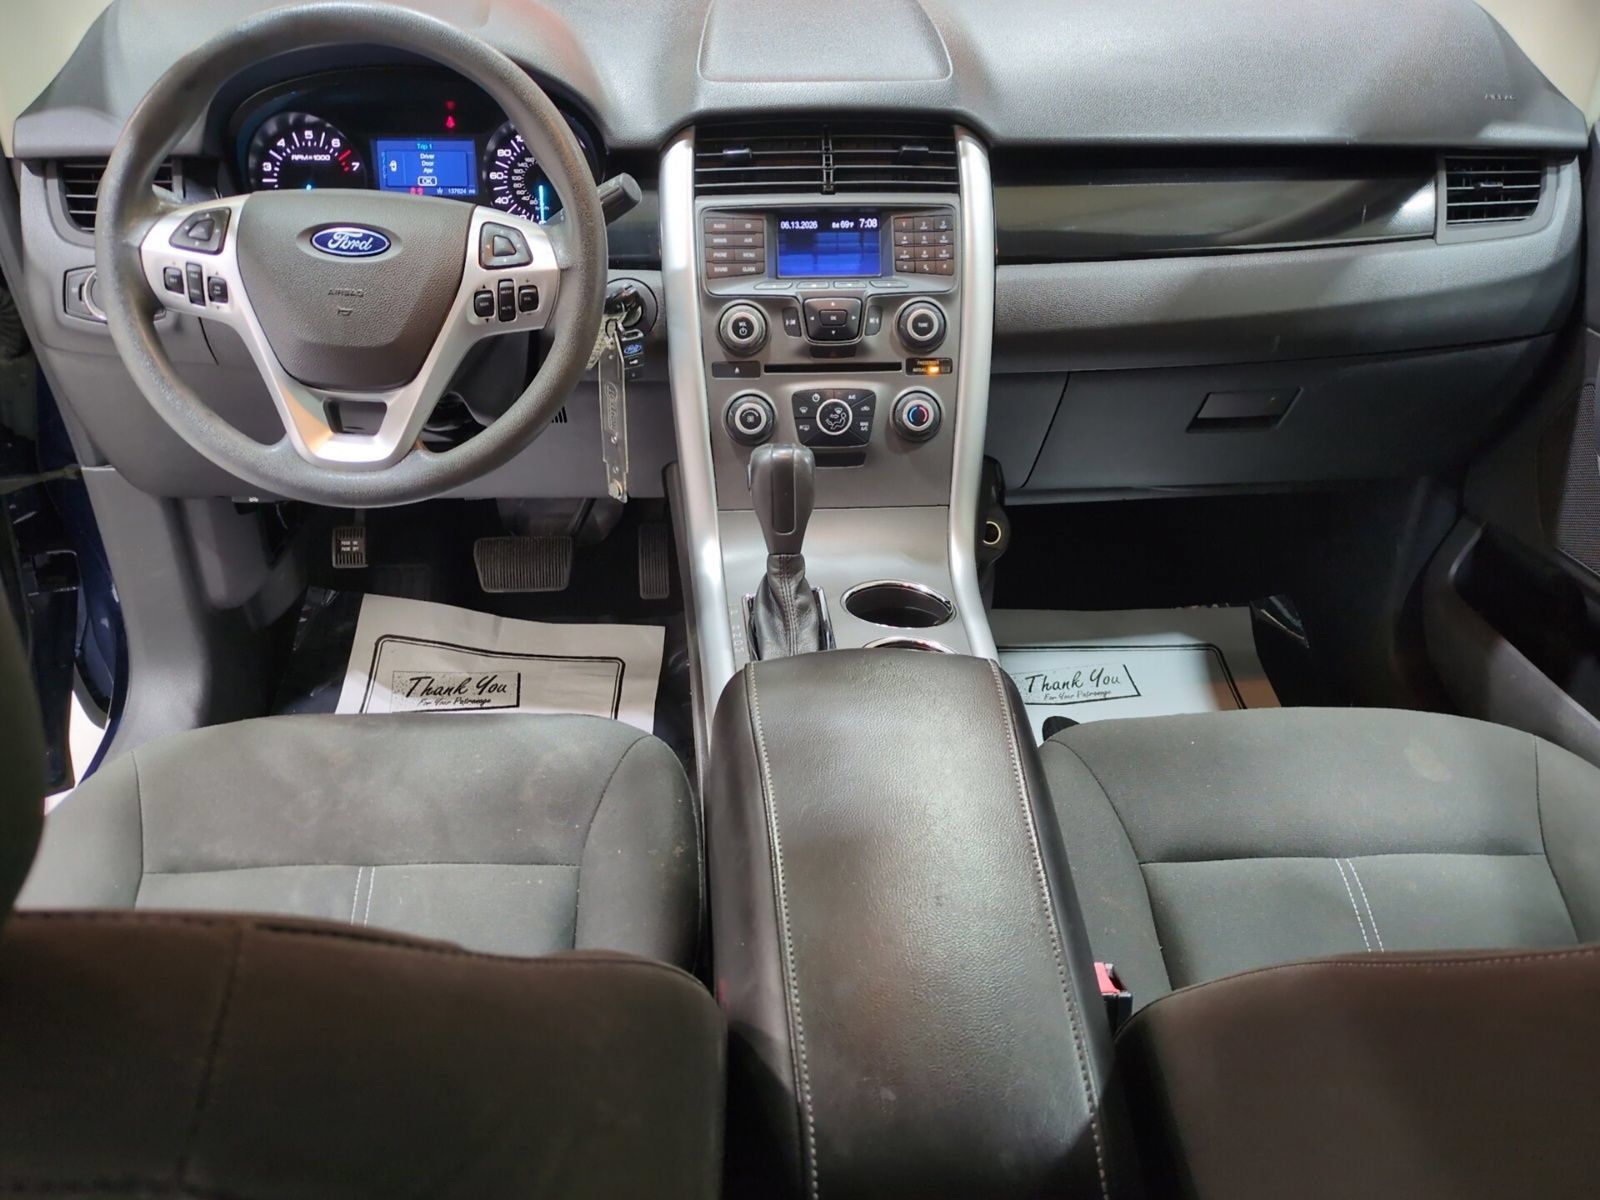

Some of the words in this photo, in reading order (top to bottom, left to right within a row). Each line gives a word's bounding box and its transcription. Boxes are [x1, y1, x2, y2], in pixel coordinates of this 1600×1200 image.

[304, 130, 314, 139] 5
[277, 138, 286, 147] 4
[331, 138, 341, 148] 6
[497, 149, 511, 157] 80
[262, 162, 272, 172] 3
[351, 162, 360, 171] 7
[489, 171, 504, 180] 60
[494, 196, 509, 204] 40
[859, 217, 878, 229] 7:08
[327, 231, 374, 251] Ford
[1025, 671, 1084, 693] Thank
[1089, 667, 1121, 688] You
[405, 676, 473, 698] Thank
[476, 674, 507, 696] You
